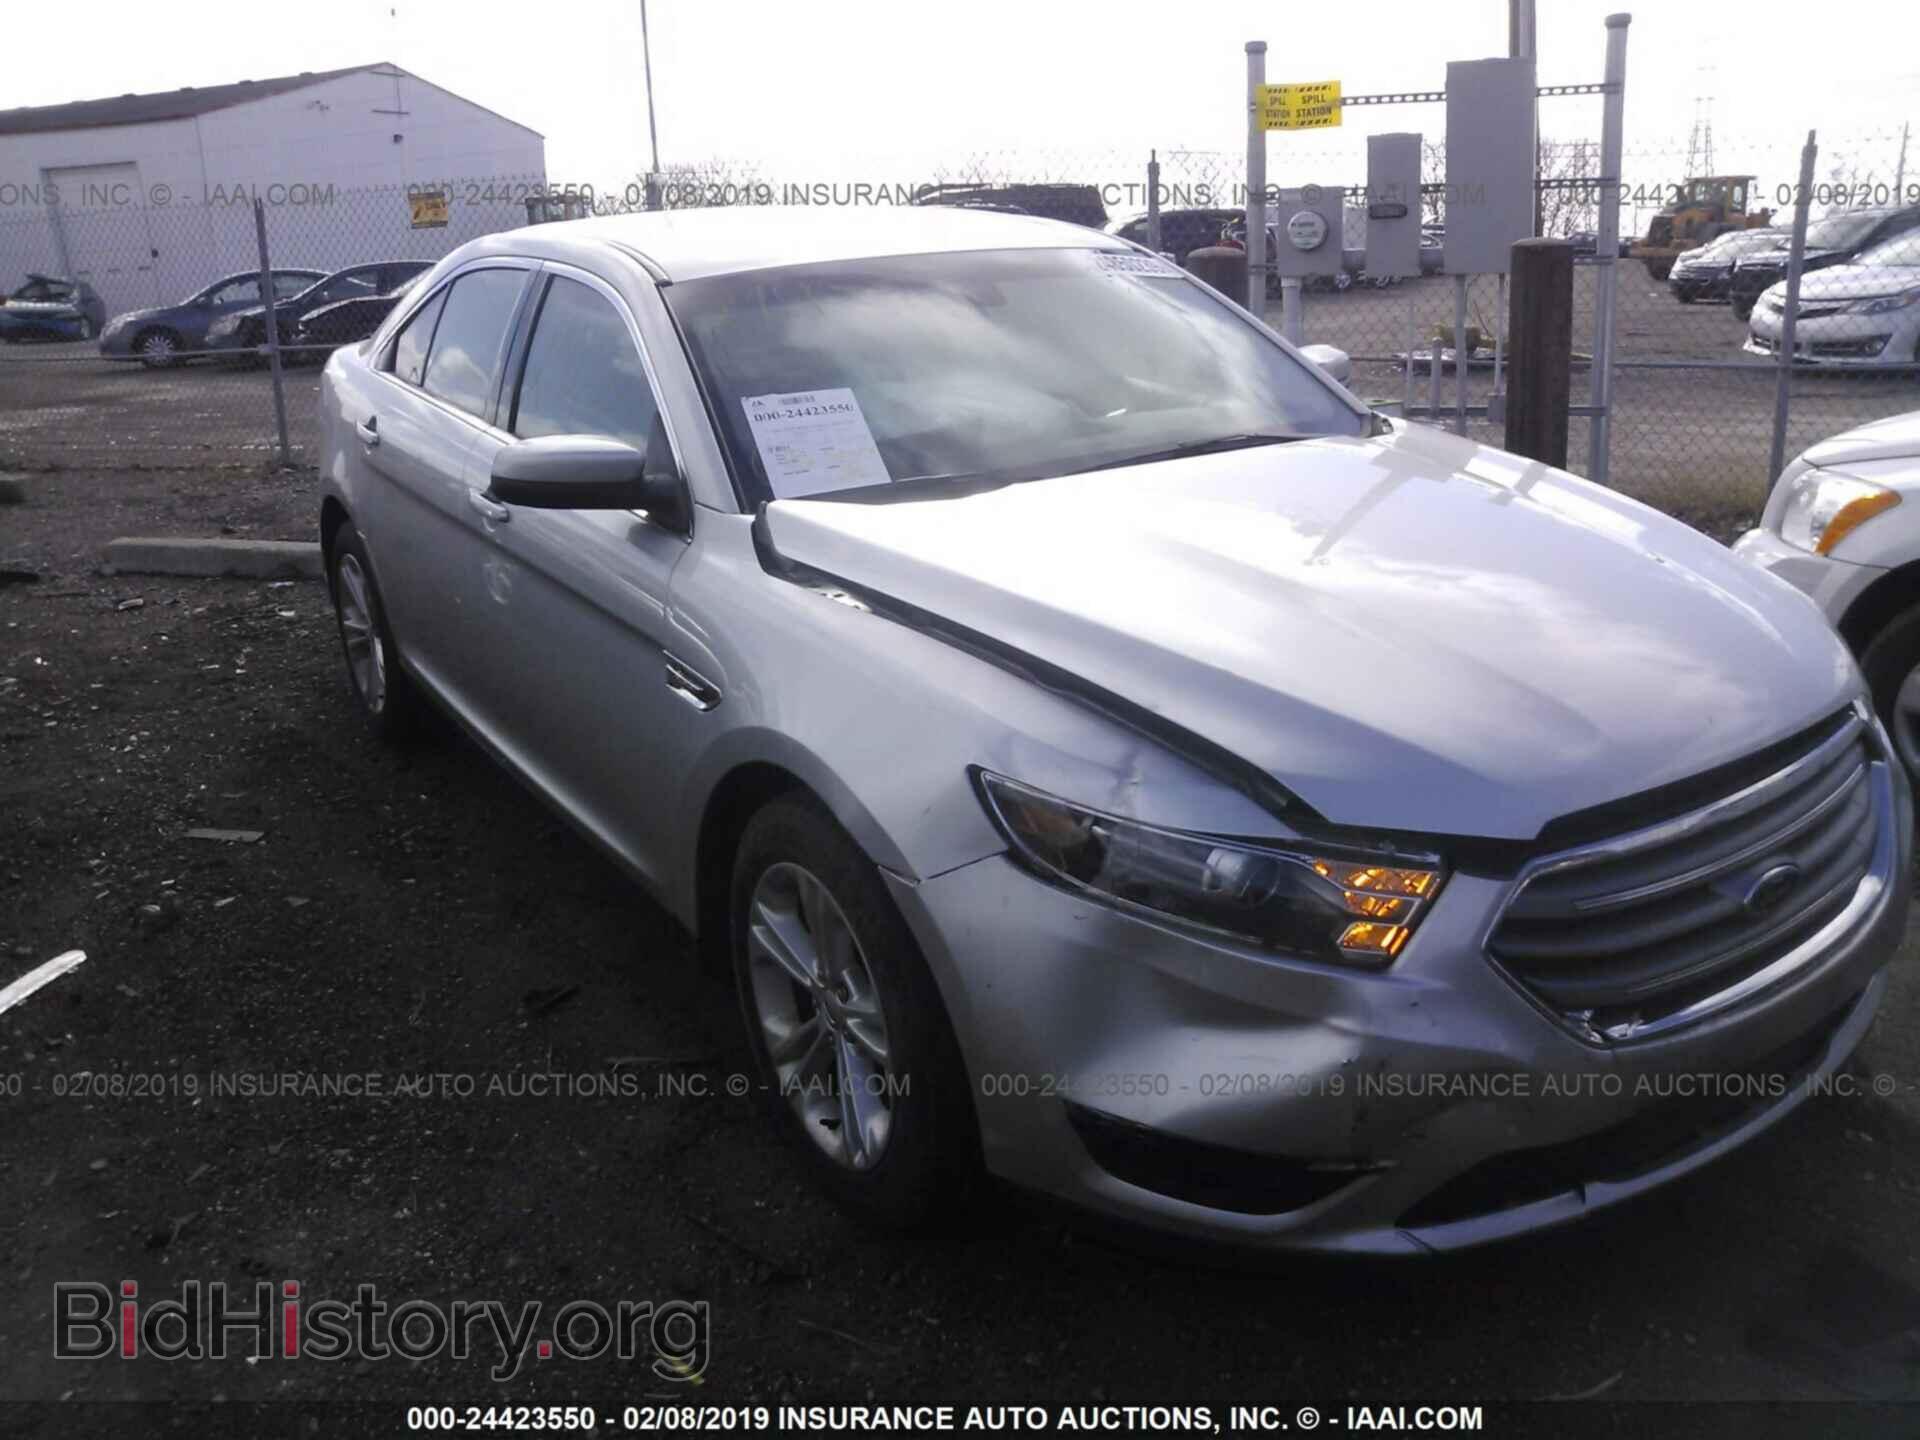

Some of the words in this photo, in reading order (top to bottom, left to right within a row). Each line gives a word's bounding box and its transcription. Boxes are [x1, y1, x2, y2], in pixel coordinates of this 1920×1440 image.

[1270, 96, 1286, 105] SPILL
[1301, 94, 1326, 104] SPILL
[1265, 109, 1290, 118] STATION
[1296, 106, 1332, 118] STATION
